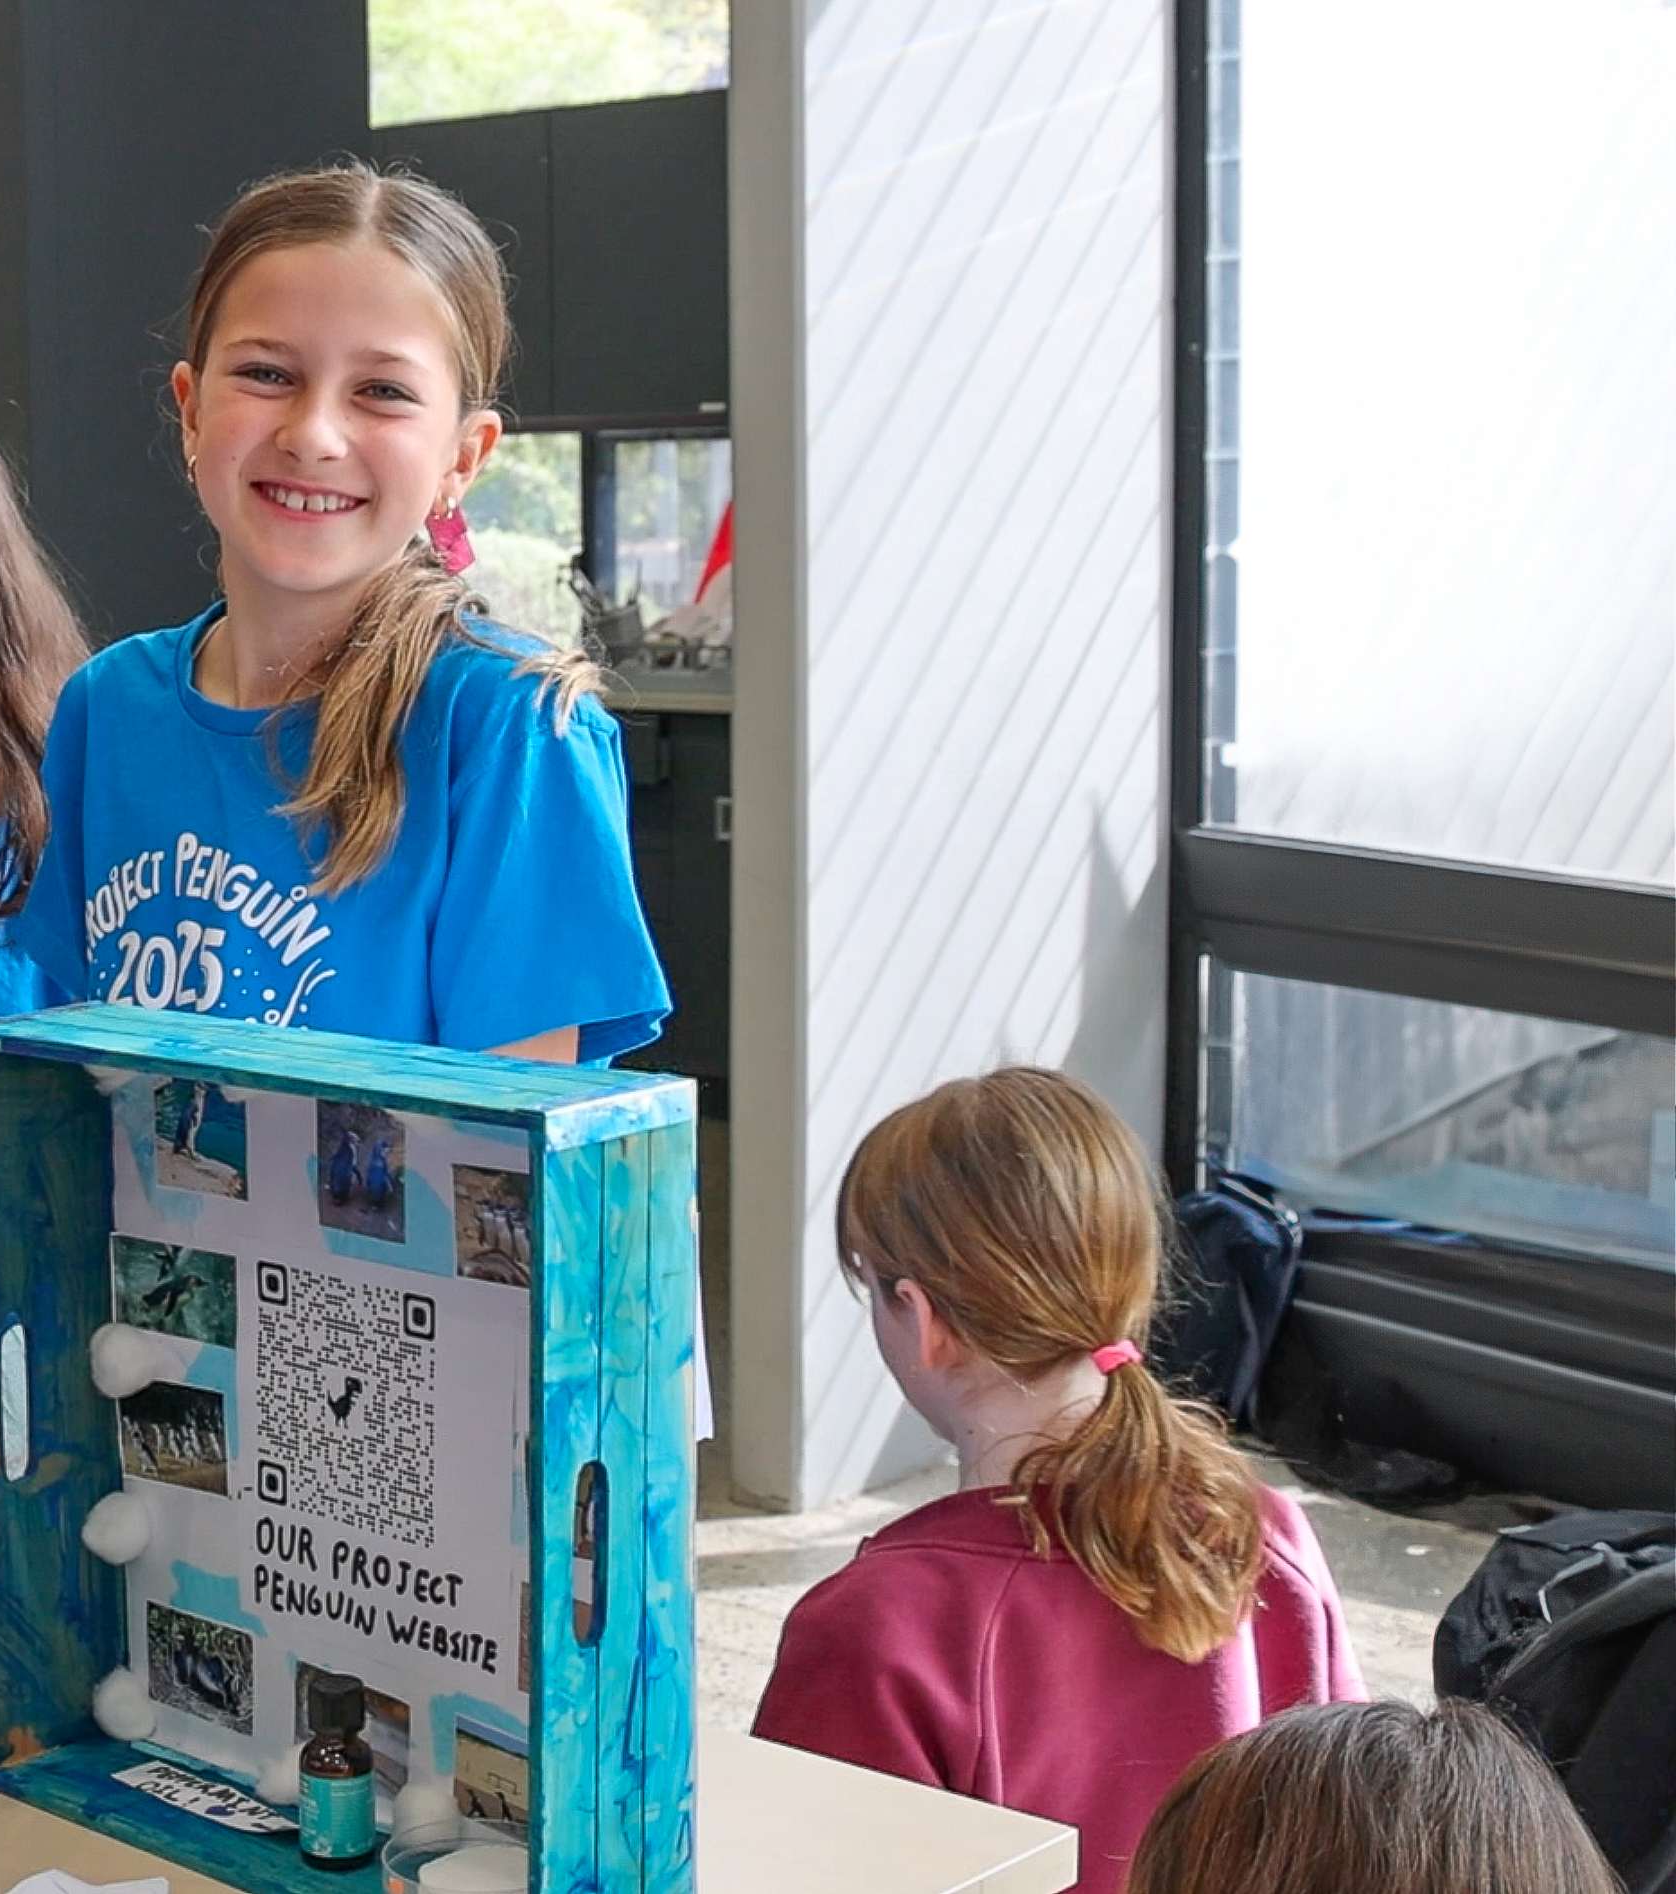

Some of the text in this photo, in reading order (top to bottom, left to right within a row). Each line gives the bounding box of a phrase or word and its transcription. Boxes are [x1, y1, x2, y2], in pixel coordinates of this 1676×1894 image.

[85, 832, 331, 967] ROJECT PENGUIN
[108, 920, 226, 1012] 2025
[255, 1516, 464, 1608] OUR PROJECT
[253, 1563, 499, 1675] PENGUIN WEBSITE
